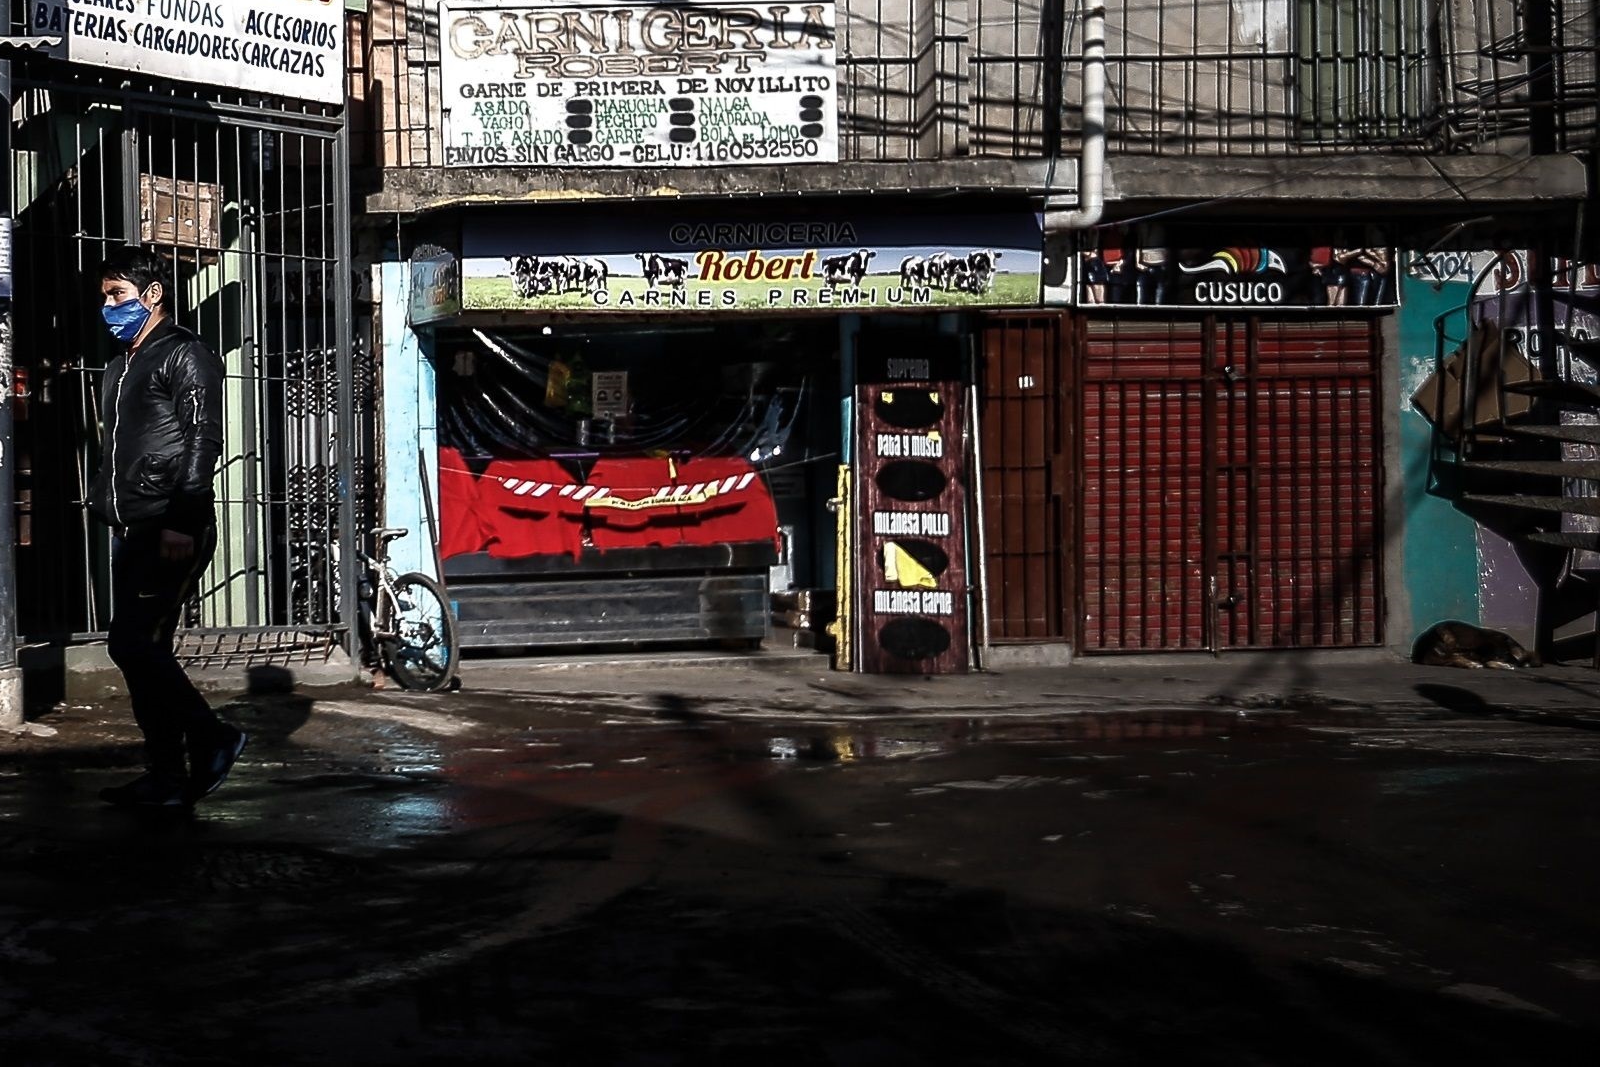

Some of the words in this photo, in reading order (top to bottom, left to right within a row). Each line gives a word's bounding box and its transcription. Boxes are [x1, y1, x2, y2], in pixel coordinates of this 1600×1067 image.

[244, 9, 338, 50] ACCESORIOS
[34, 2, 129, 44] BATERIAS
[133, 22, 240, 62] CARGADORES
[242, 41, 325, 78] CARCAZAS
[514, 50, 767, 79] ROBERT
[537, 82, 562, 97] DE
[574, 80, 666, 97] PRIMERA
[677, 78, 708, 94] DE
[715, 76, 830, 93] NOVILLITO
[471, 100, 529, 116] ASADO
[594, 98, 668, 114] MARUCHA
[699, 97, 752, 112] NALGA
[595, 114, 657, 128] PECHITO
[699, 111, 771, 126] CUADRADA
[484, 130, 504, 146] DE
[511, 130, 563, 146] ASADO
[595, 129, 645, 143] CARRE
[700, 127, 735, 143] BOLA
[762, 125, 800, 141] LOMO
[445, 146, 508, 165] ENVIOS
[515, 145, 548, 163] SIN
[554, 144, 614, 162] CARGO
[670, 222, 858, 246] CARNICERIA
[695, 248, 816, 281] Robert
[593, 289, 737, 306] CARNES
[769, 287, 931, 305] PREMIUM
[1195, 281, 1282, 303] CUSUCO
